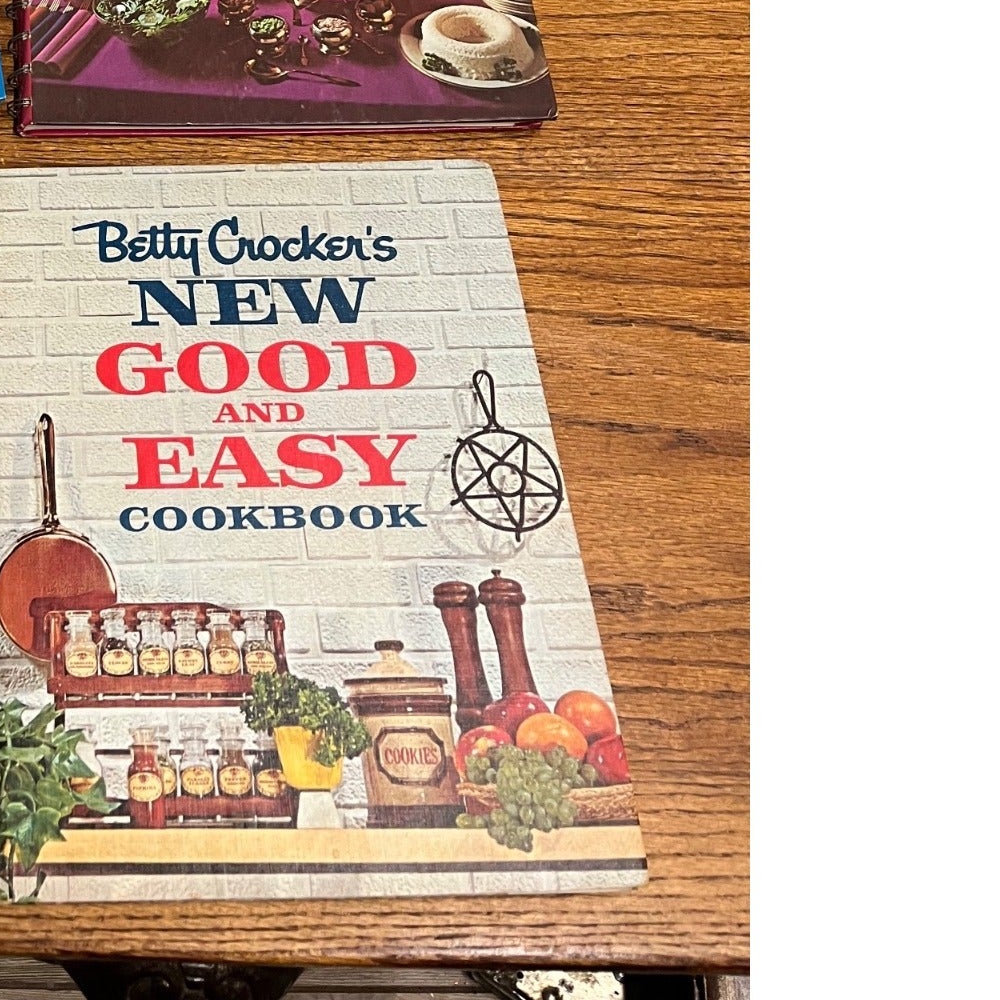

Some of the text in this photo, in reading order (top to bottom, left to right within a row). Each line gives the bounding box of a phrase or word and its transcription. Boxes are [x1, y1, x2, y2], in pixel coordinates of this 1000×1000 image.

[72, 216, 398, 275] Betty Crocker's
[128, 277, 376, 326] NEW
[96, 340, 417, 395] GOOD
[212, 402, 305, 423] AND
[122, 434, 417, 489] EASY
[119, 503, 428, 532] COOKBOOK
[384, 746, 439, 765] COOKIES
